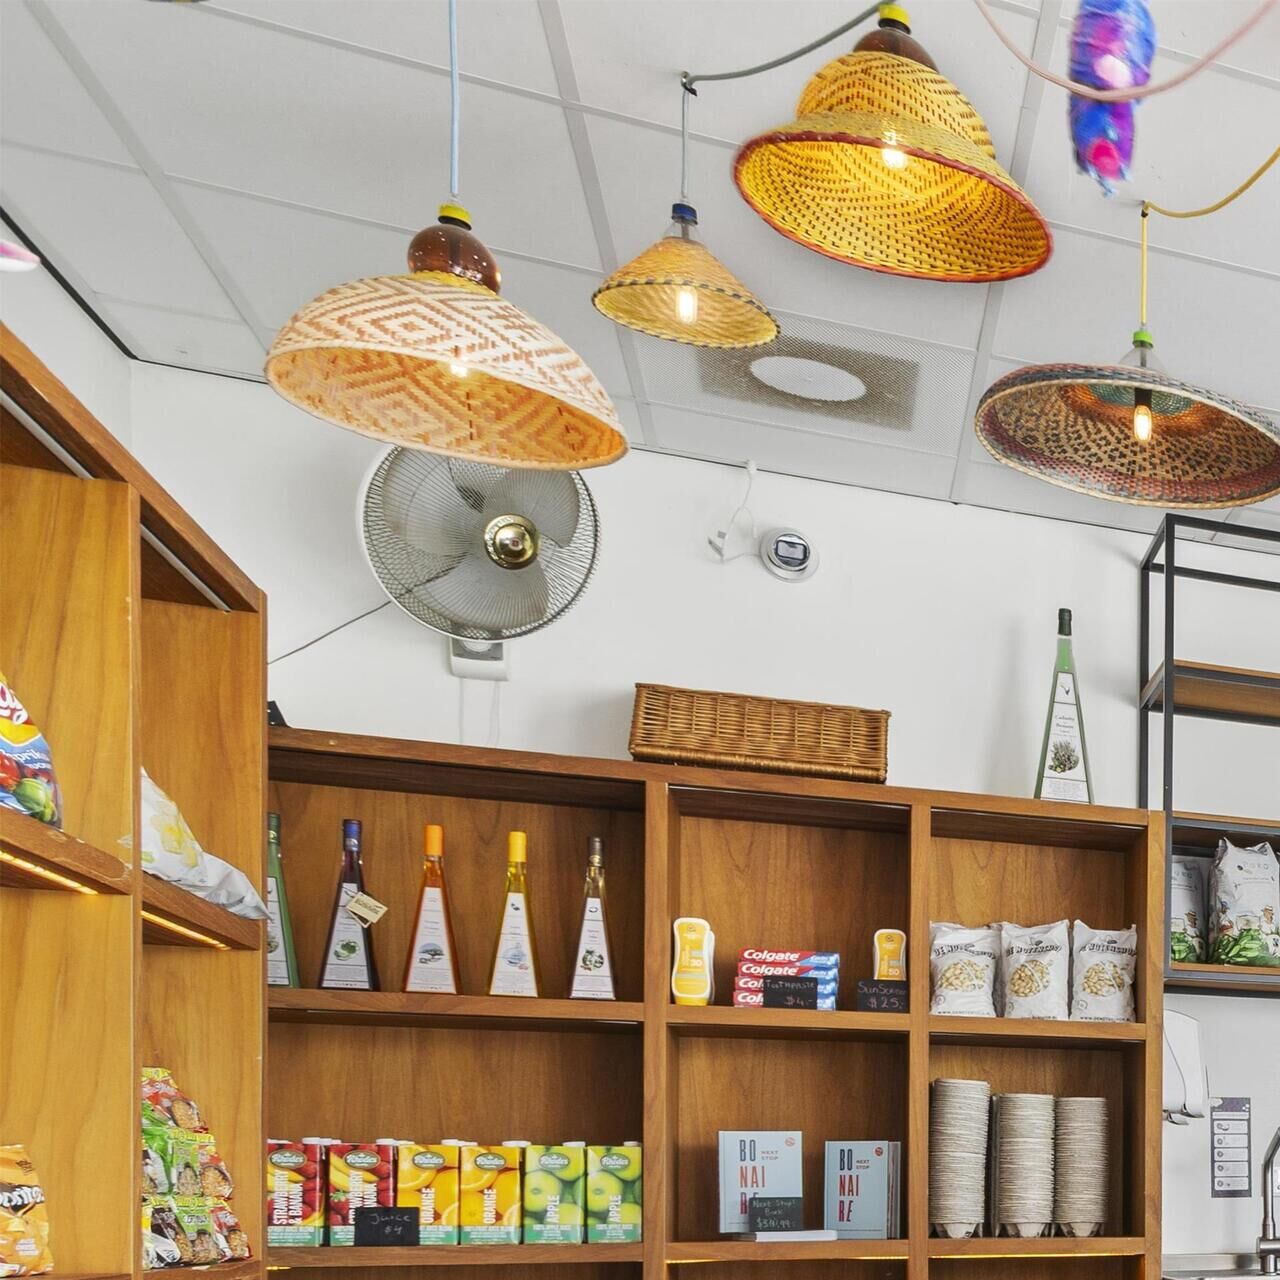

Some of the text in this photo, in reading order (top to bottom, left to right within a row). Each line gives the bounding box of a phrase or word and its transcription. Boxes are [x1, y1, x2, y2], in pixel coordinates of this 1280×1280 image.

[743, 949, 800, 963] Colgate
[741, 963, 799, 976] Colgate
[740, 1139, 756, 1162] BO
[839, 1149, 852, 1171] BO
[740, 1166, 766, 1188] NAI
[839, 1175, 859, 1197] NAI
[273, 1170, 288, 1225] STRAWBERRY
[289, 1183, 303, 1216] BANANA
[422, 1188, 435, 1223] ORANGE
[483, 1188, 497, 1224] ORANGE
[547, 1195, 560, 1222] APPLE
[609, 1195, 622, 1222] APPLE
[839, 1201, 853, 1222] RE
